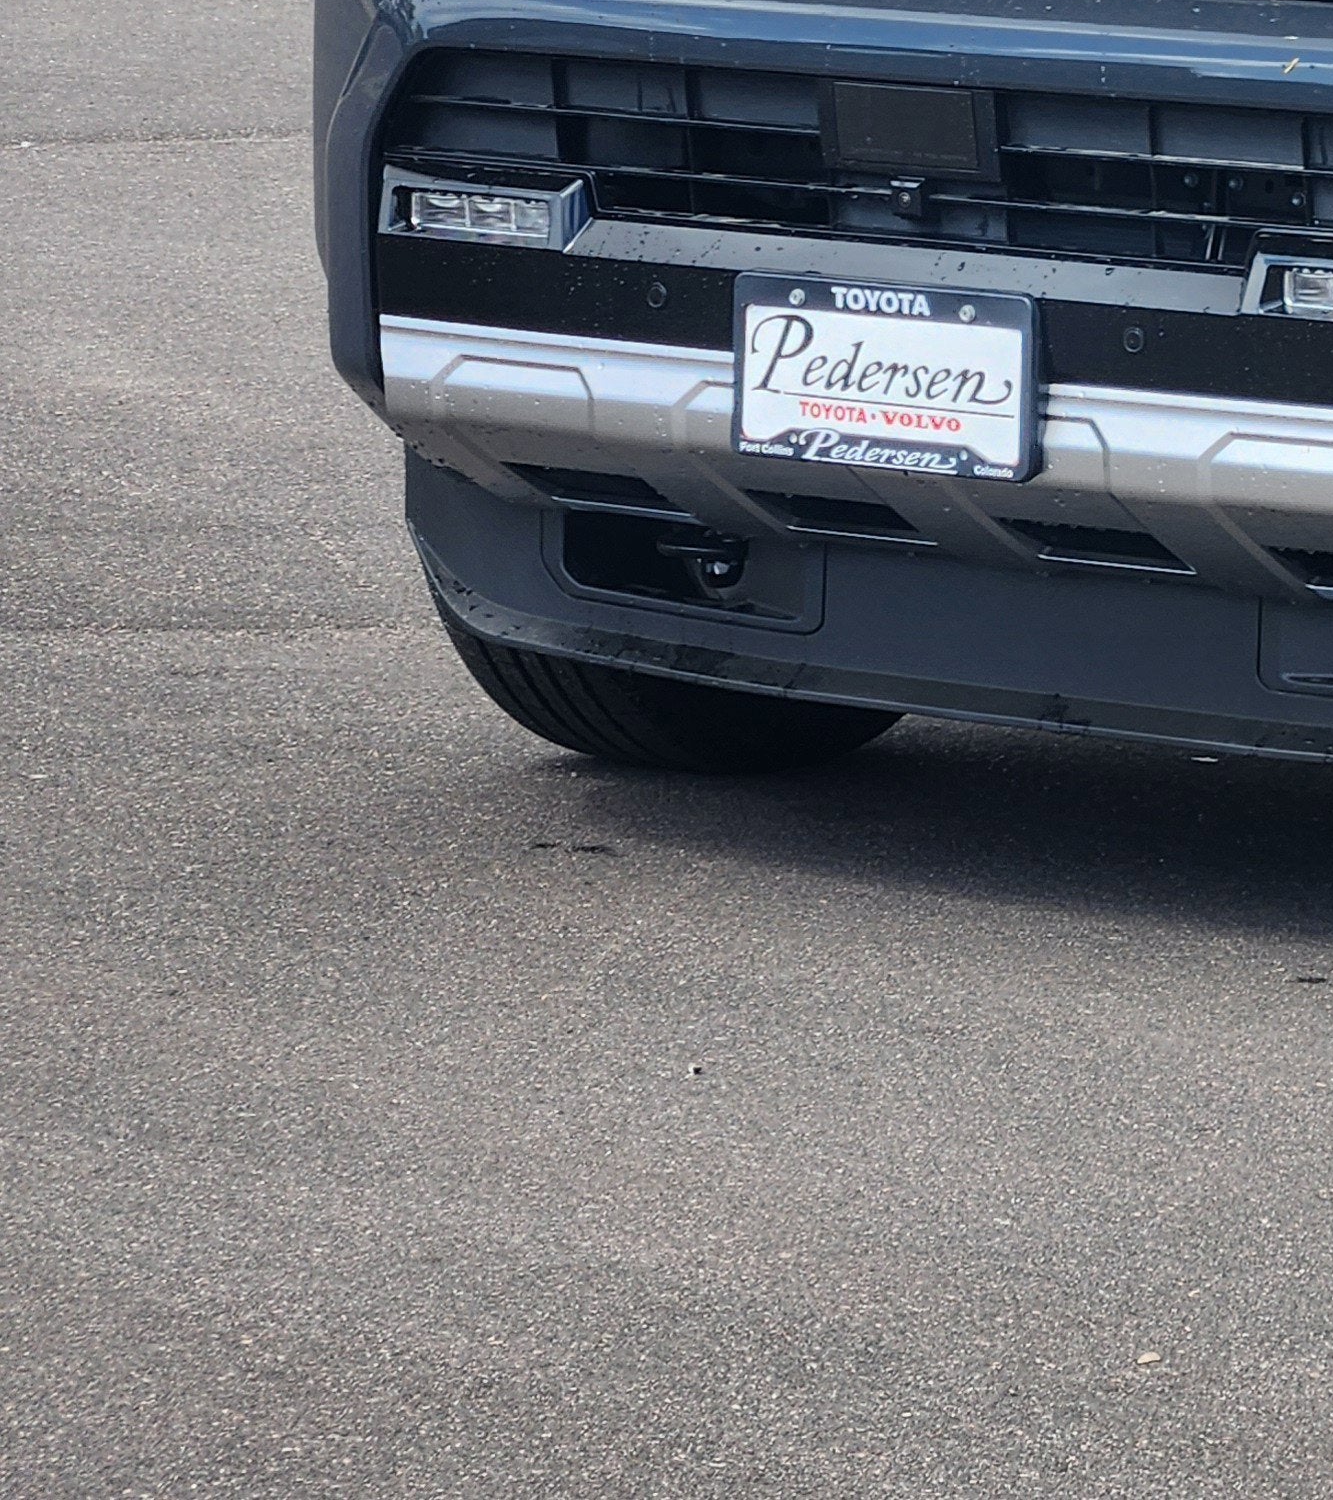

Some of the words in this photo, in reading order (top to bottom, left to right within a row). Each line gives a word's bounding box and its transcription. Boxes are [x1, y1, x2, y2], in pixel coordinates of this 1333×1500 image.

[831, 286, 931, 317] TOYOTA
[751, 314, 1013, 405] Pedersen
[799, 400, 867, 425] TOYOTA
[880, 410, 962, 433] VOLVO
[797, 428, 958, 472] Pedersen
